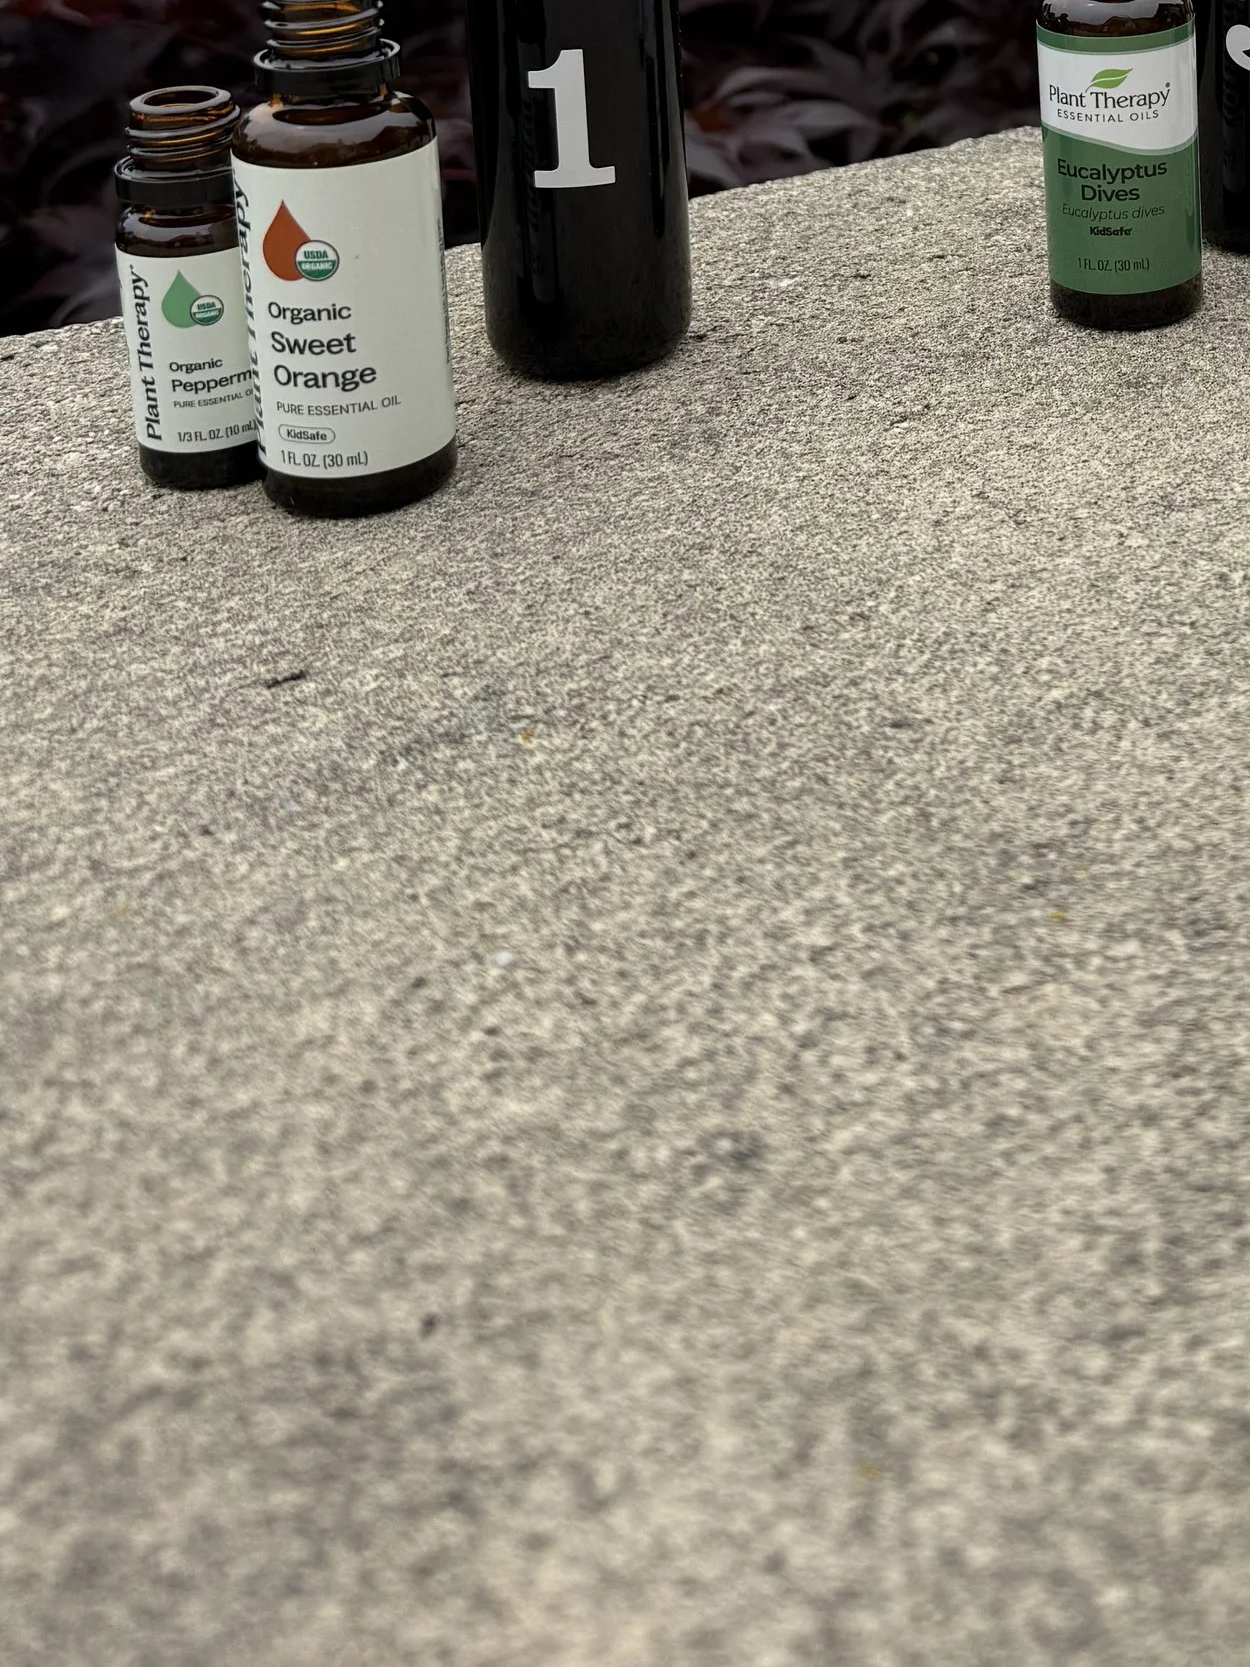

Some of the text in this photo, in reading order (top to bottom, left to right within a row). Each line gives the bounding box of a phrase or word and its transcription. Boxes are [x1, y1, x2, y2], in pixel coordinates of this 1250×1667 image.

[1049, 84, 1086, 108] Plant
[528, 49, 616, 188] 1
[1057, 109, 1159, 123] ESSENTIAL OILS
[1057, 158, 1168, 184] Eucalyptus
[1081, 184, 1140, 202] Dives
[1062, 203, 1165, 222] Eucalyptus dives
[1089, 226, 1133, 236] KidSafe
[303, 250, 329, 260] USDA
[301, 261, 333, 271] ORGANIC
[1084, 258, 1096, 271] FL.
[1097, 259, 1112, 271] OZ.
[1114, 259, 1131, 273] (30
[1133, 258, 1150, 271] mL)
[268, 301, 352, 325] Organic
[270, 331, 356, 355] Sweet
[131, 269, 162, 441] Plant Therapy
[169, 358, 223, 374] Organic
[273, 364, 377, 392] Orange
[173, 400, 196, 408] PURE
[198, 392, 244, 407] ESSENTIAL
[276, 395, 402, 416] PURE ESSENTIAL OIL
[178, 431, 193, 442] 1/3
[194, 431, 208, 442] FL.
[209, 428, 224, 439] OZ.
[225, 425, 240, 440] (10
[286, 428, 328, 441] KidSafe
[287, 451, 301, 466] FL.
[303, 452, 321, 468] OZ.
[323, 453, 344, 470] (30
[347, 451, 369, 466] mL)
